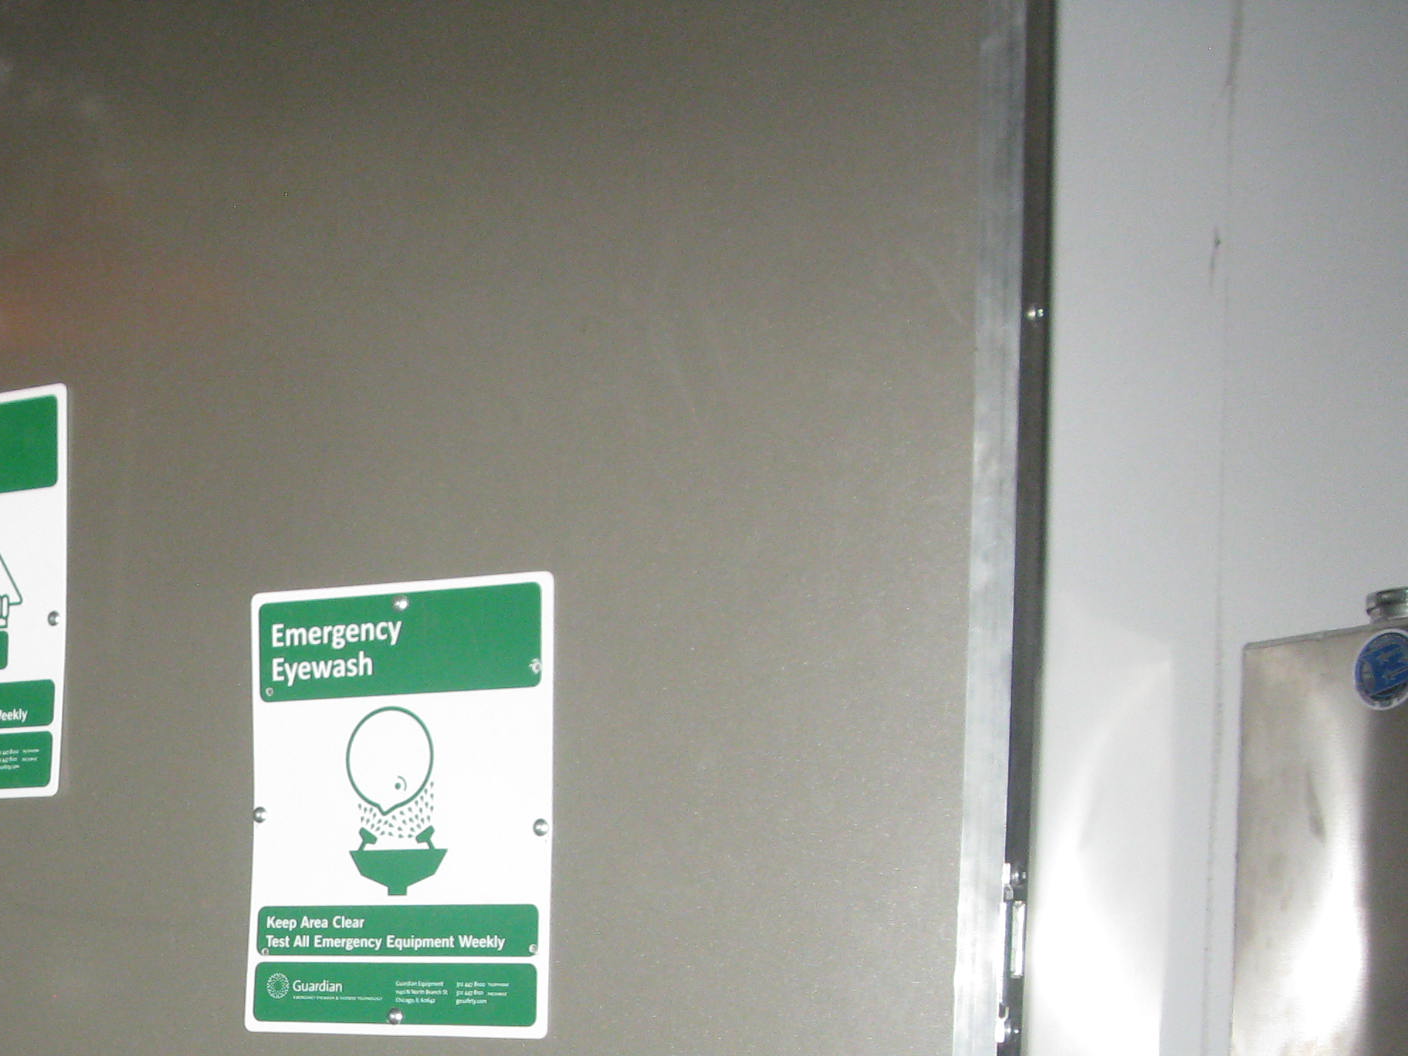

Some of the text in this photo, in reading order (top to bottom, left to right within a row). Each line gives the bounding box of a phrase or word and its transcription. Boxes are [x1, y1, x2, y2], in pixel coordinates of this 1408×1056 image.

[271, 620, 402, 650] Emergency
[271, 651, 373, 686] Eyewash
[266, 915, 365, 931] Keep Area Clear
[266, 934, 506, 951] Test All Emergency Equipment Weekly
[292, 979, 343, 992] Guardian
